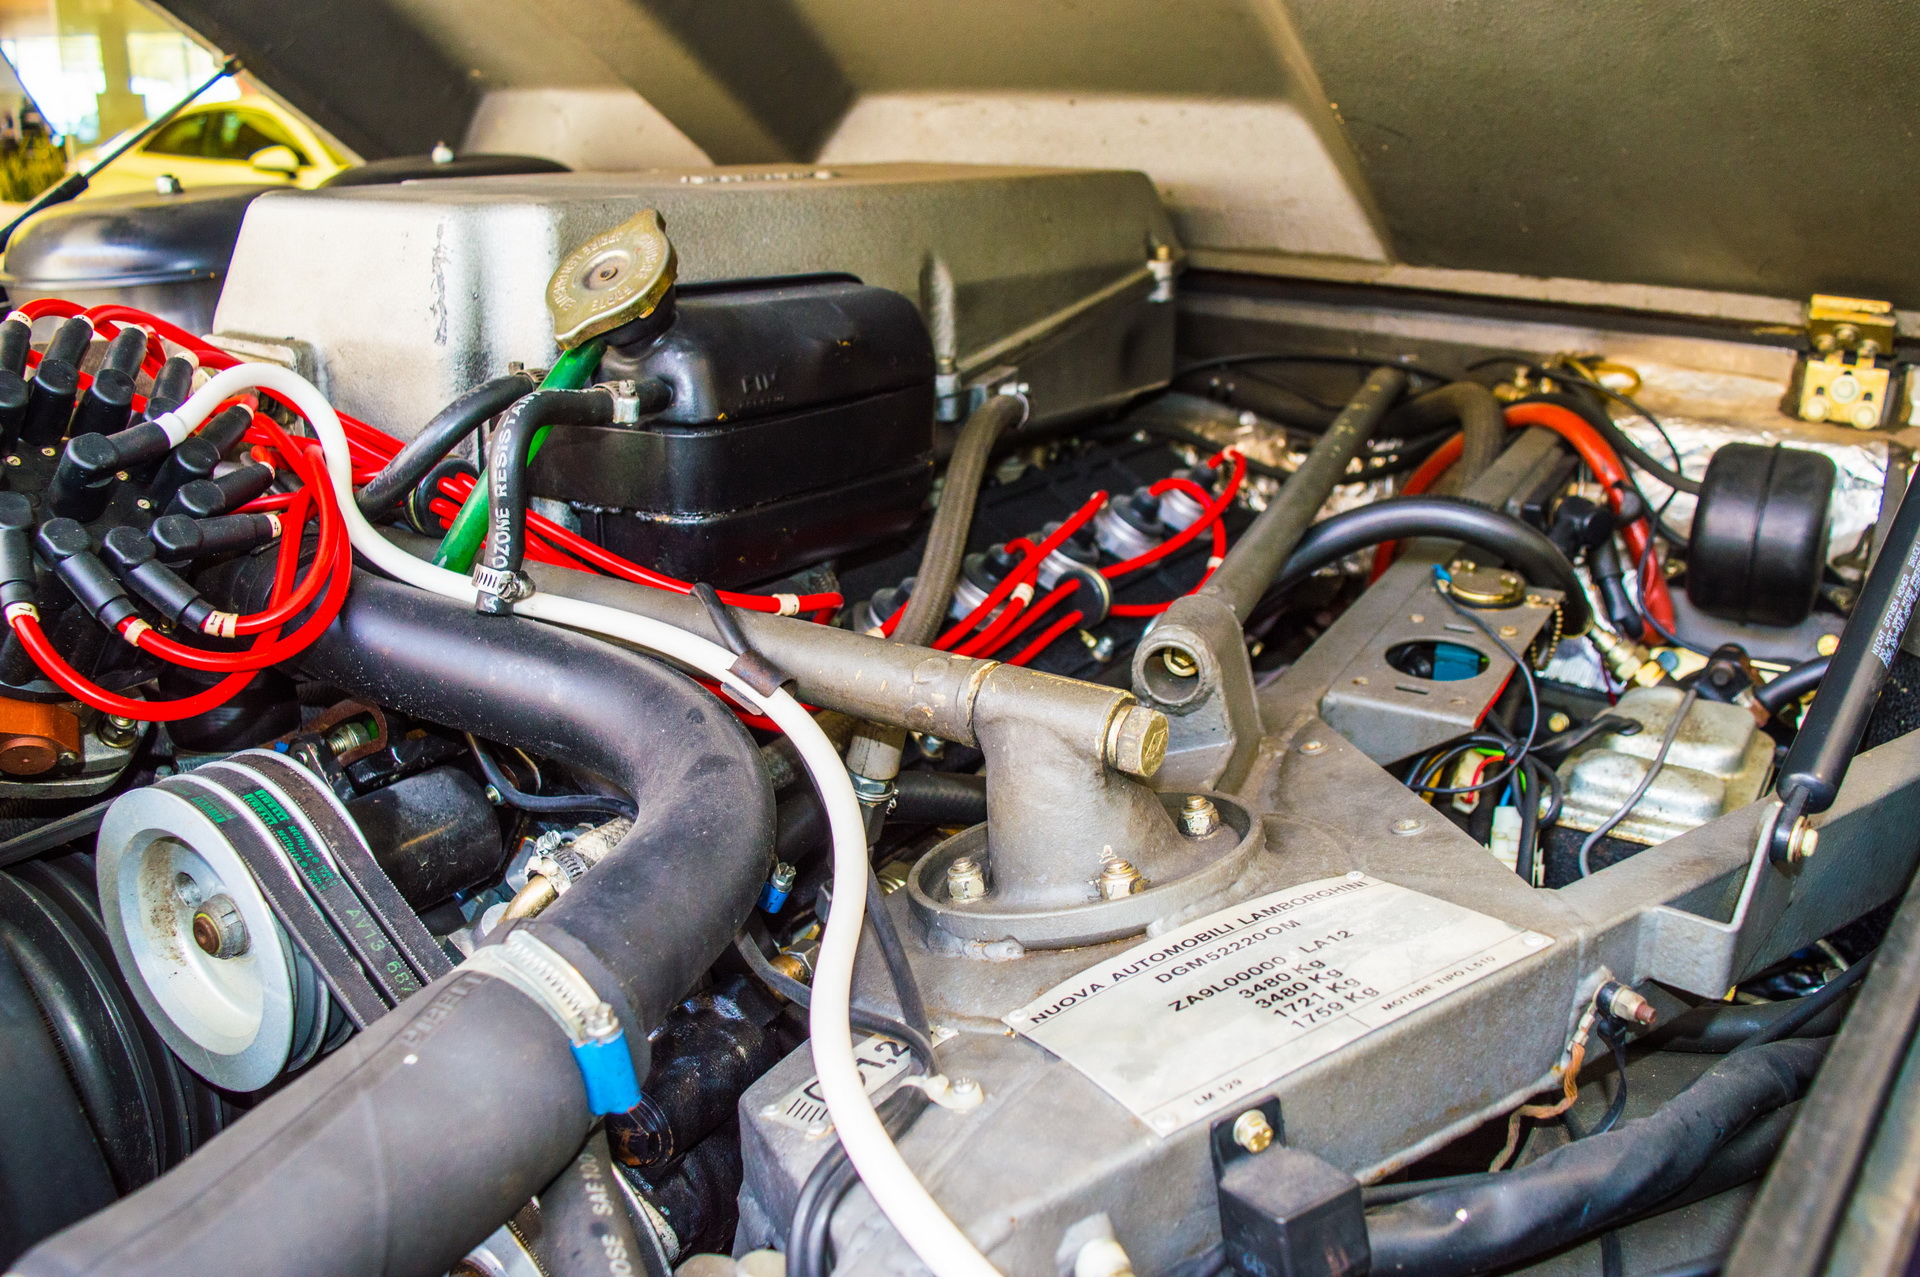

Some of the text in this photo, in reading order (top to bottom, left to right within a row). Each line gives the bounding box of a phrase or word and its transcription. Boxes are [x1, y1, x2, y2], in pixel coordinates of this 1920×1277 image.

[591, 285, 635, 312] FORTE
[491, 506, 511, 570] OZONE
[345, 909, 387, 952] AV13
[1029, 880, 1369, 1024] NUOVA AUTOMOBILI LAMBORGHINI
[1168, 930, 1354, 1012] ZA9L00000 LA12
[1238, 959, 1326, 999] 3480 Kg
[1255, 968, 1343, 1009] 3480 Kg
[1273, 977, 1361, 1018] 1721 Kg
[1381, 984, 1434, 1011] MOTORE
[1435, 970, 1465, 985] TIPO
[1291, 987, 1380, 1029] 1759 Kg
[584, 1182, 614, 1216] SAE
[601, 1233, 632, 1277] OSE
